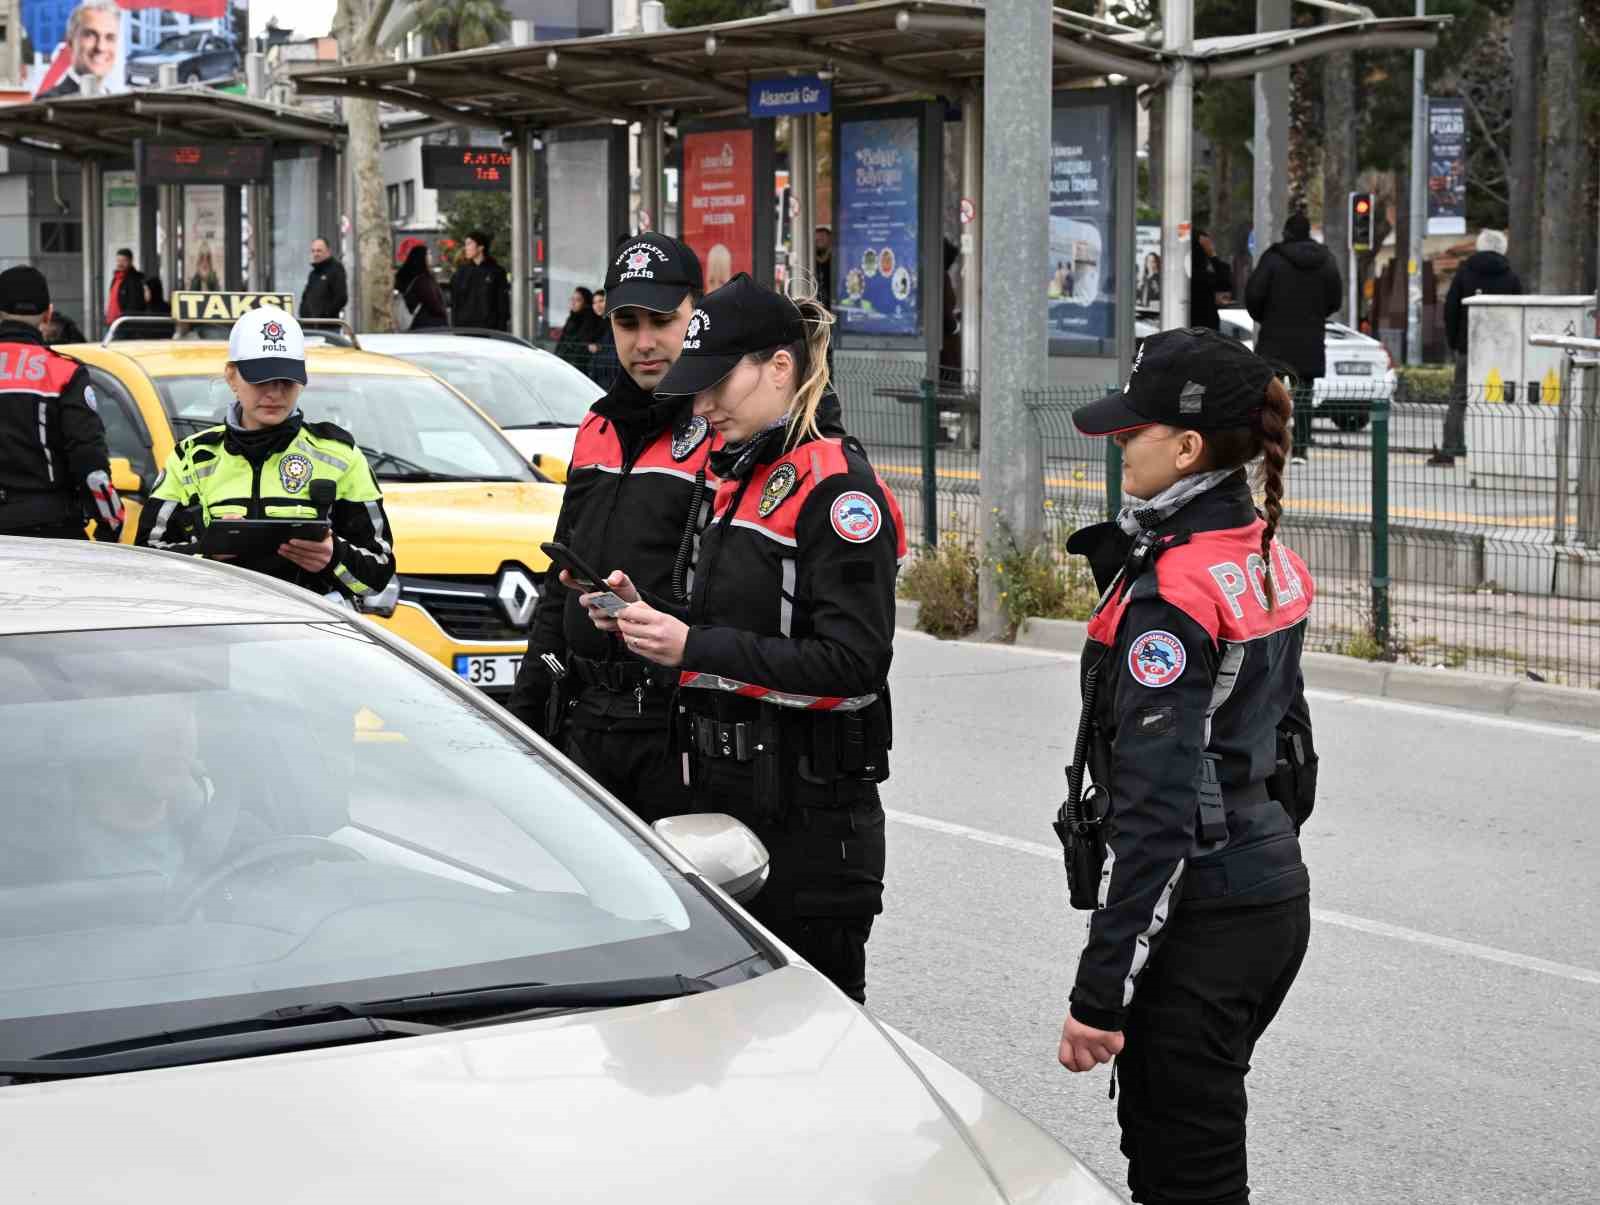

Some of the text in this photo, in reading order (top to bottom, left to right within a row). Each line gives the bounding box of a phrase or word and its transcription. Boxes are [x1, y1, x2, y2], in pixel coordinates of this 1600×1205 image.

[760, 87, 819, 106] Alsancak Gar
[620, 269, 654, 282] POLİS
[262, 344, 287, 352] POLİS
[683, 340, 701, 349] OLİS
[0, 347, 47, 380] LİS
[470, 659, 496, 683] 35
